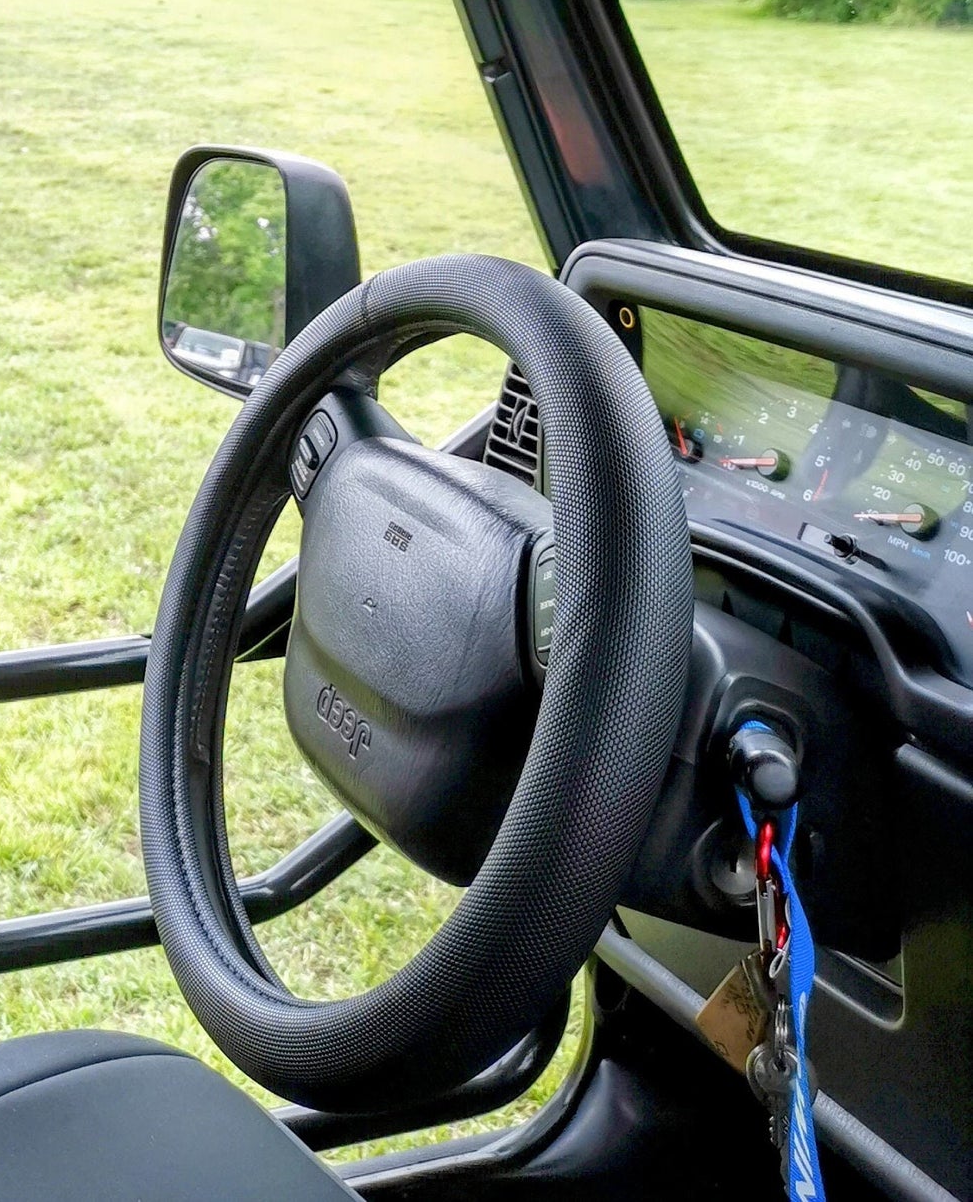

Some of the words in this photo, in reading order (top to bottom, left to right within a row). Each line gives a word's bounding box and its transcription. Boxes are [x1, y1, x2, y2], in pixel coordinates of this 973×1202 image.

[758, 413, 769, 424] 2
[787, 406, 797, 418] 3
[808, 423, 819, 434] 4
[738, 435, 745, 445] 1
[815, 455, 825, 467] 5
[905, 458, 922, 471] 40
[927, 453, 945, 466] 50
[948, 462, 966, 476] 60
[887, 470, 905, 483] 30
[802, 489, 814, 501] 6
[873, 486, 891, 500] 20
[962, 501, 973, 514] 8
[383, 530, 409, 553] SRS
[887, 535, 909, 550] MPH
[944, 549, 966, 565] 100
[316, 683, 372, 760] Jeep
